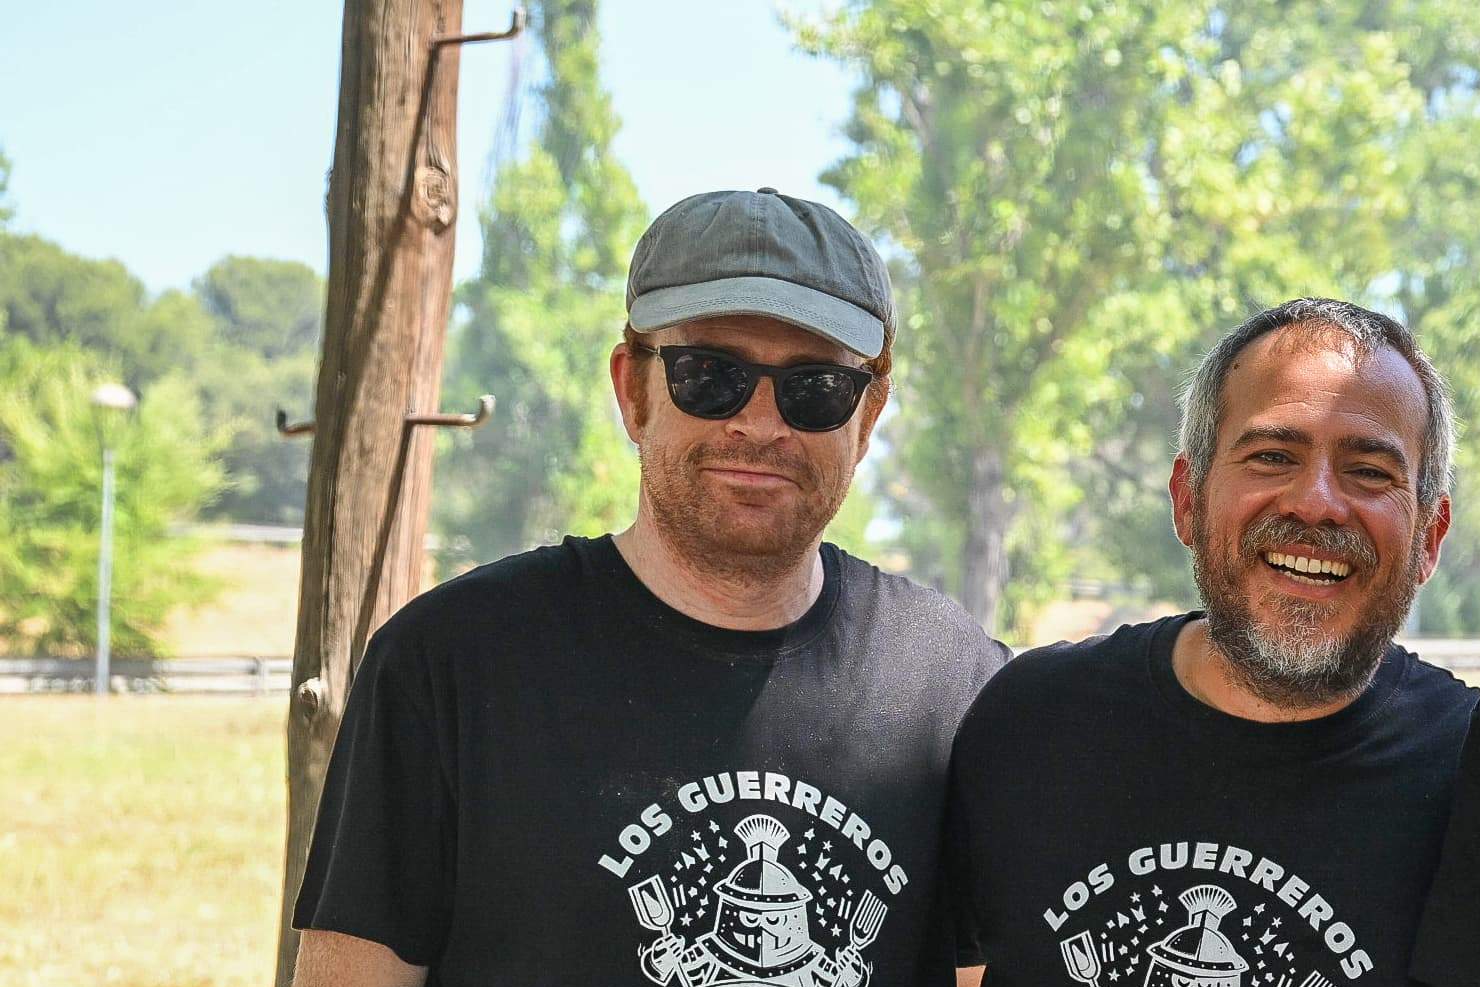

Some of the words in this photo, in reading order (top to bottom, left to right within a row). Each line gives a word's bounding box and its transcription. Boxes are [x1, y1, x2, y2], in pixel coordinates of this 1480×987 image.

[598, 803, 673, 878] LOS
[678, 770, 909, 895] GUERREROS
[1043, 863, 1115, 932] LOS
[1128, 841, 1374, 979] GUERREROS
